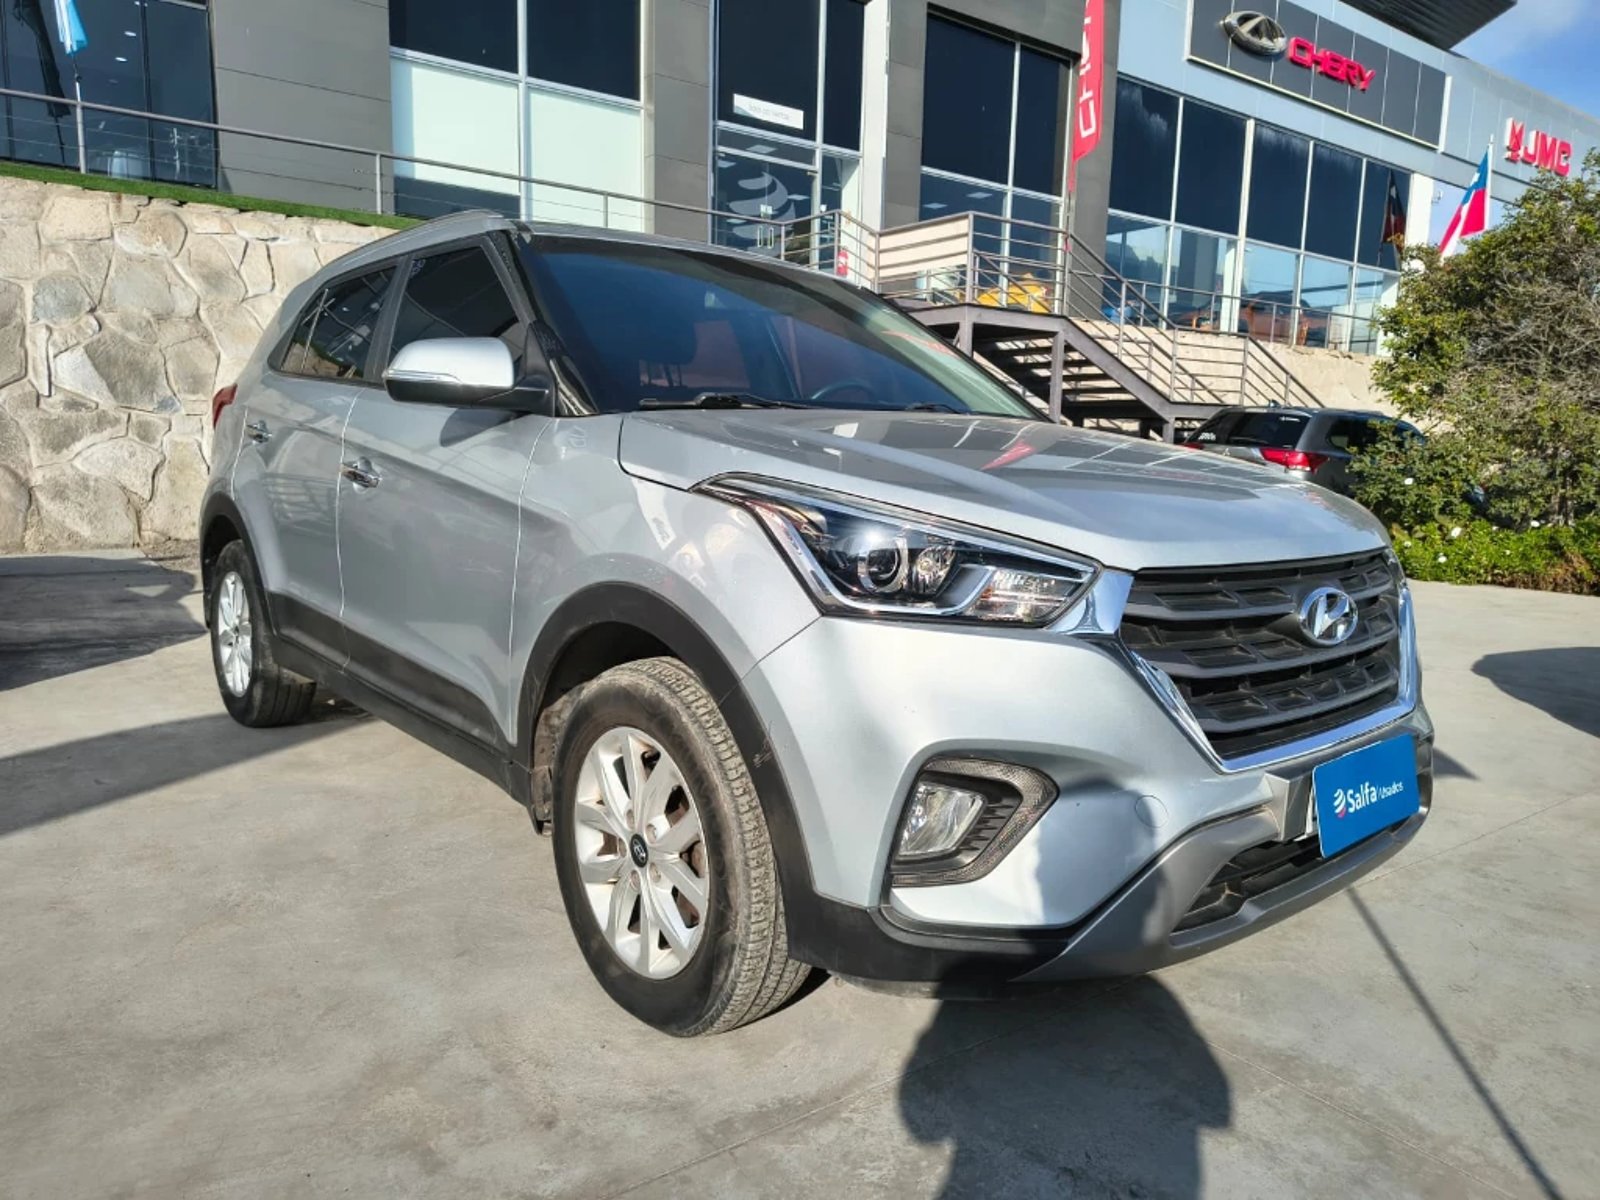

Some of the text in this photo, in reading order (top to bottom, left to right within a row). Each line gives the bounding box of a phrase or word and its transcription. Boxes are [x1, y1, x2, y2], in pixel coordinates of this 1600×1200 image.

[1288, 37, 1376, 91] CHERY
[1521, 130, 1573, 177] JMC
[1346, 781, 1378, 813] Salfa
